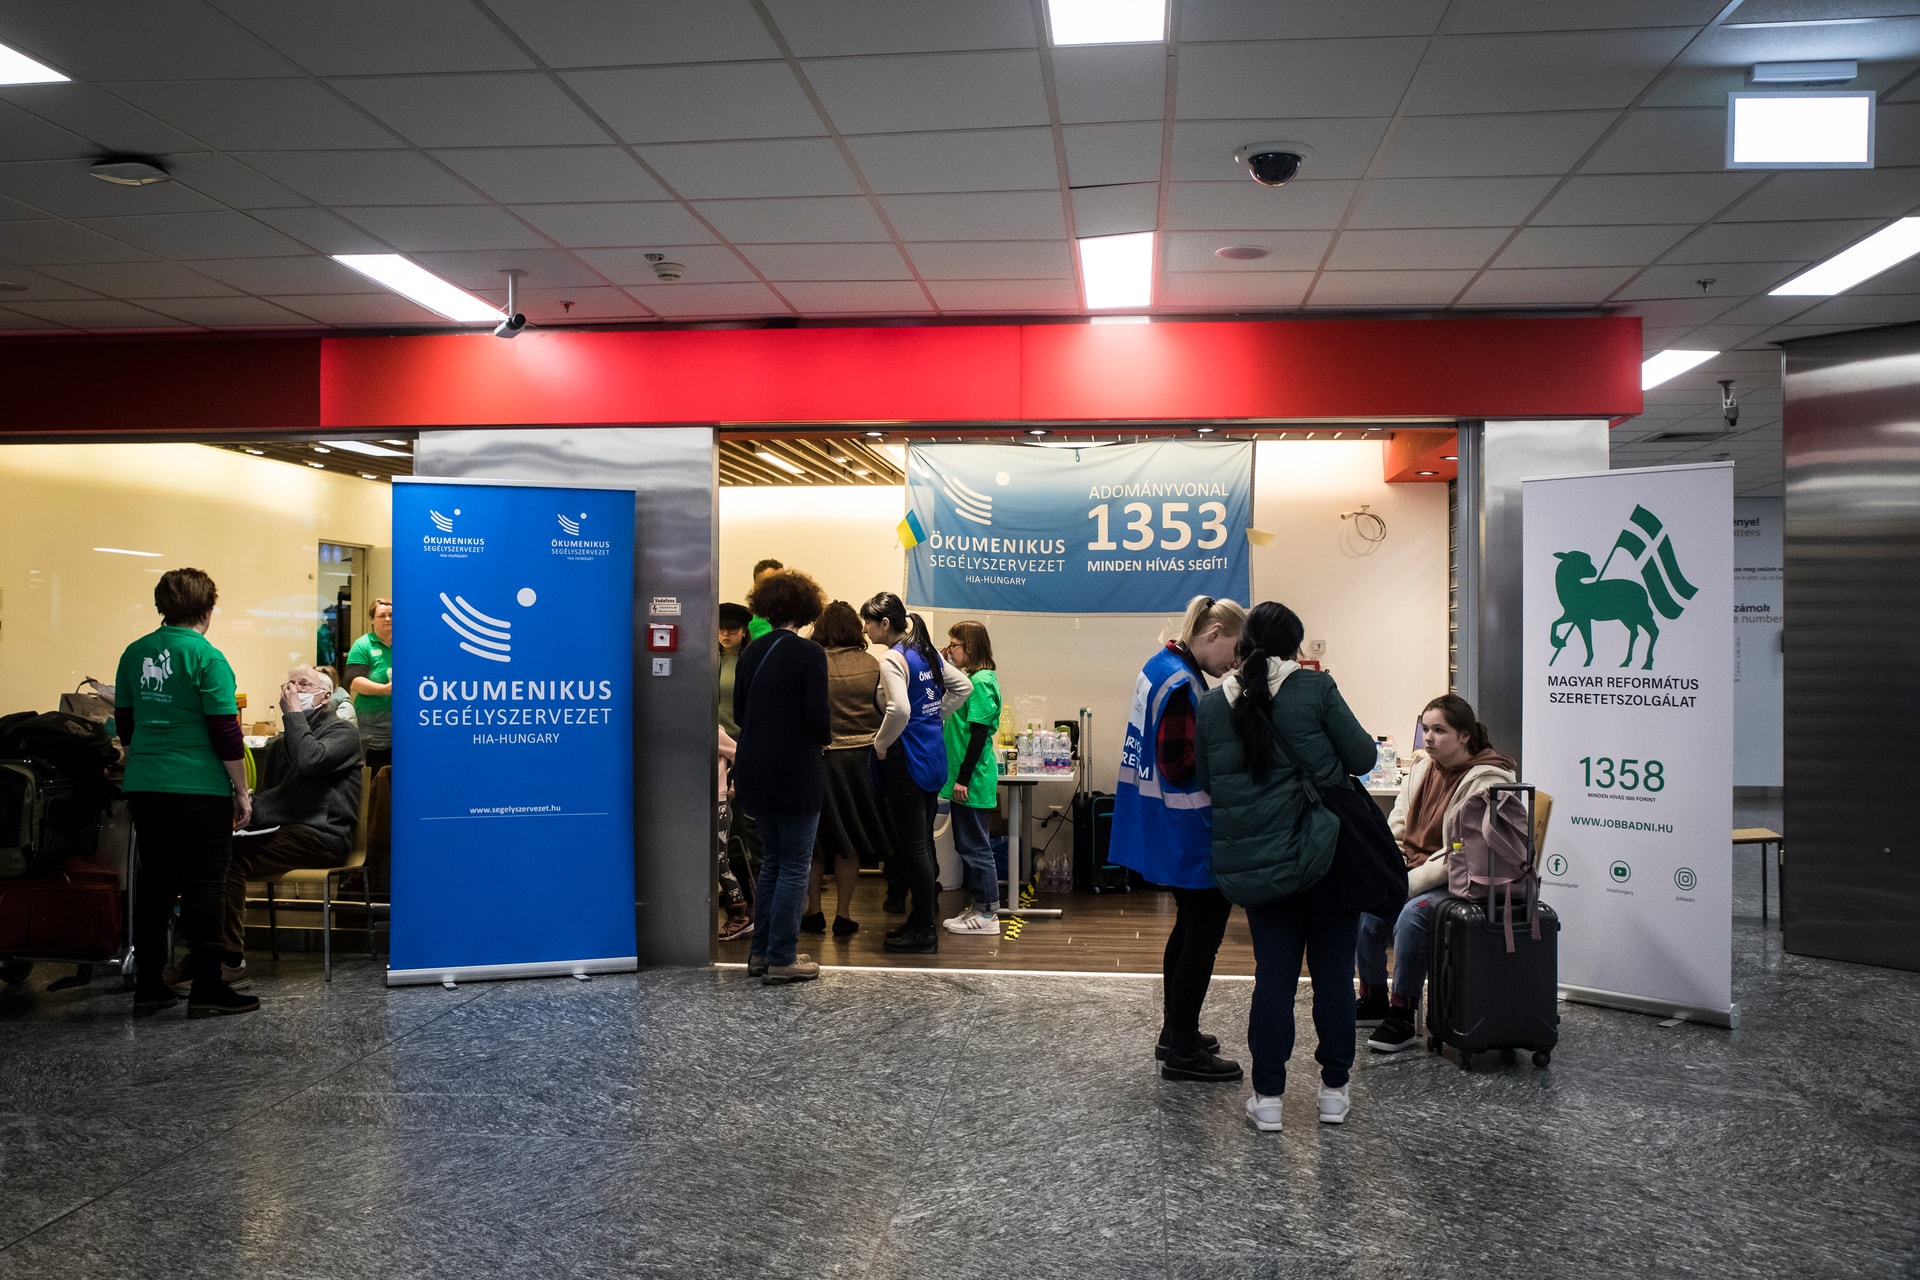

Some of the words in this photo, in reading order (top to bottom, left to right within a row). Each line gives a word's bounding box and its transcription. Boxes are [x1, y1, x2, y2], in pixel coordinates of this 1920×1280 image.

[1088, 480, 1229, 499] ADOMÁNYVONAL
[1087, 501, 1228, 551] 1353
[423, 535, 485, 545] ÖKUMENIKUS
[551, 538, 610, 548] ÖKUMENIKUS
[929, 530, 1066, 555] ÖKUMENIKUS
[423, 545, 485, 553] SEGÉLYSZERVEZET
[551, 548, 610, 556] SEGÉLYSZERVEZET
[929, 553, 1066, 572] SEGÉLYSZERVEZET
[1087, 560, 1142, 572] MINDEN
[1146, 557, 1185, 572] HÍVÁS
[1188, 555, 1228, 571] SEGÍT!
[965, 575, 1027, 586] HIA-HUNGARY
[418, 675, 613, 702] ÖKUMENIKUS
[1548, 675, 1603, 688] MAGYAR
[1607, 675, 1700, 691] REFORMÁTUS
[1549, 692, 1697, 708] SZERETETSZOLGÁLAT
[418, 705, 612, 726] SEGÉLYSZERVEZET
[473, 733, 560, 745] HIA-HUNGARY
[1579, 756, 1665, 793] 1358
[469, 804, 561, 815] www.segelyszervezet.hu
[1571, 816, 1674, 833] WWW.JOBBADNI.HU
